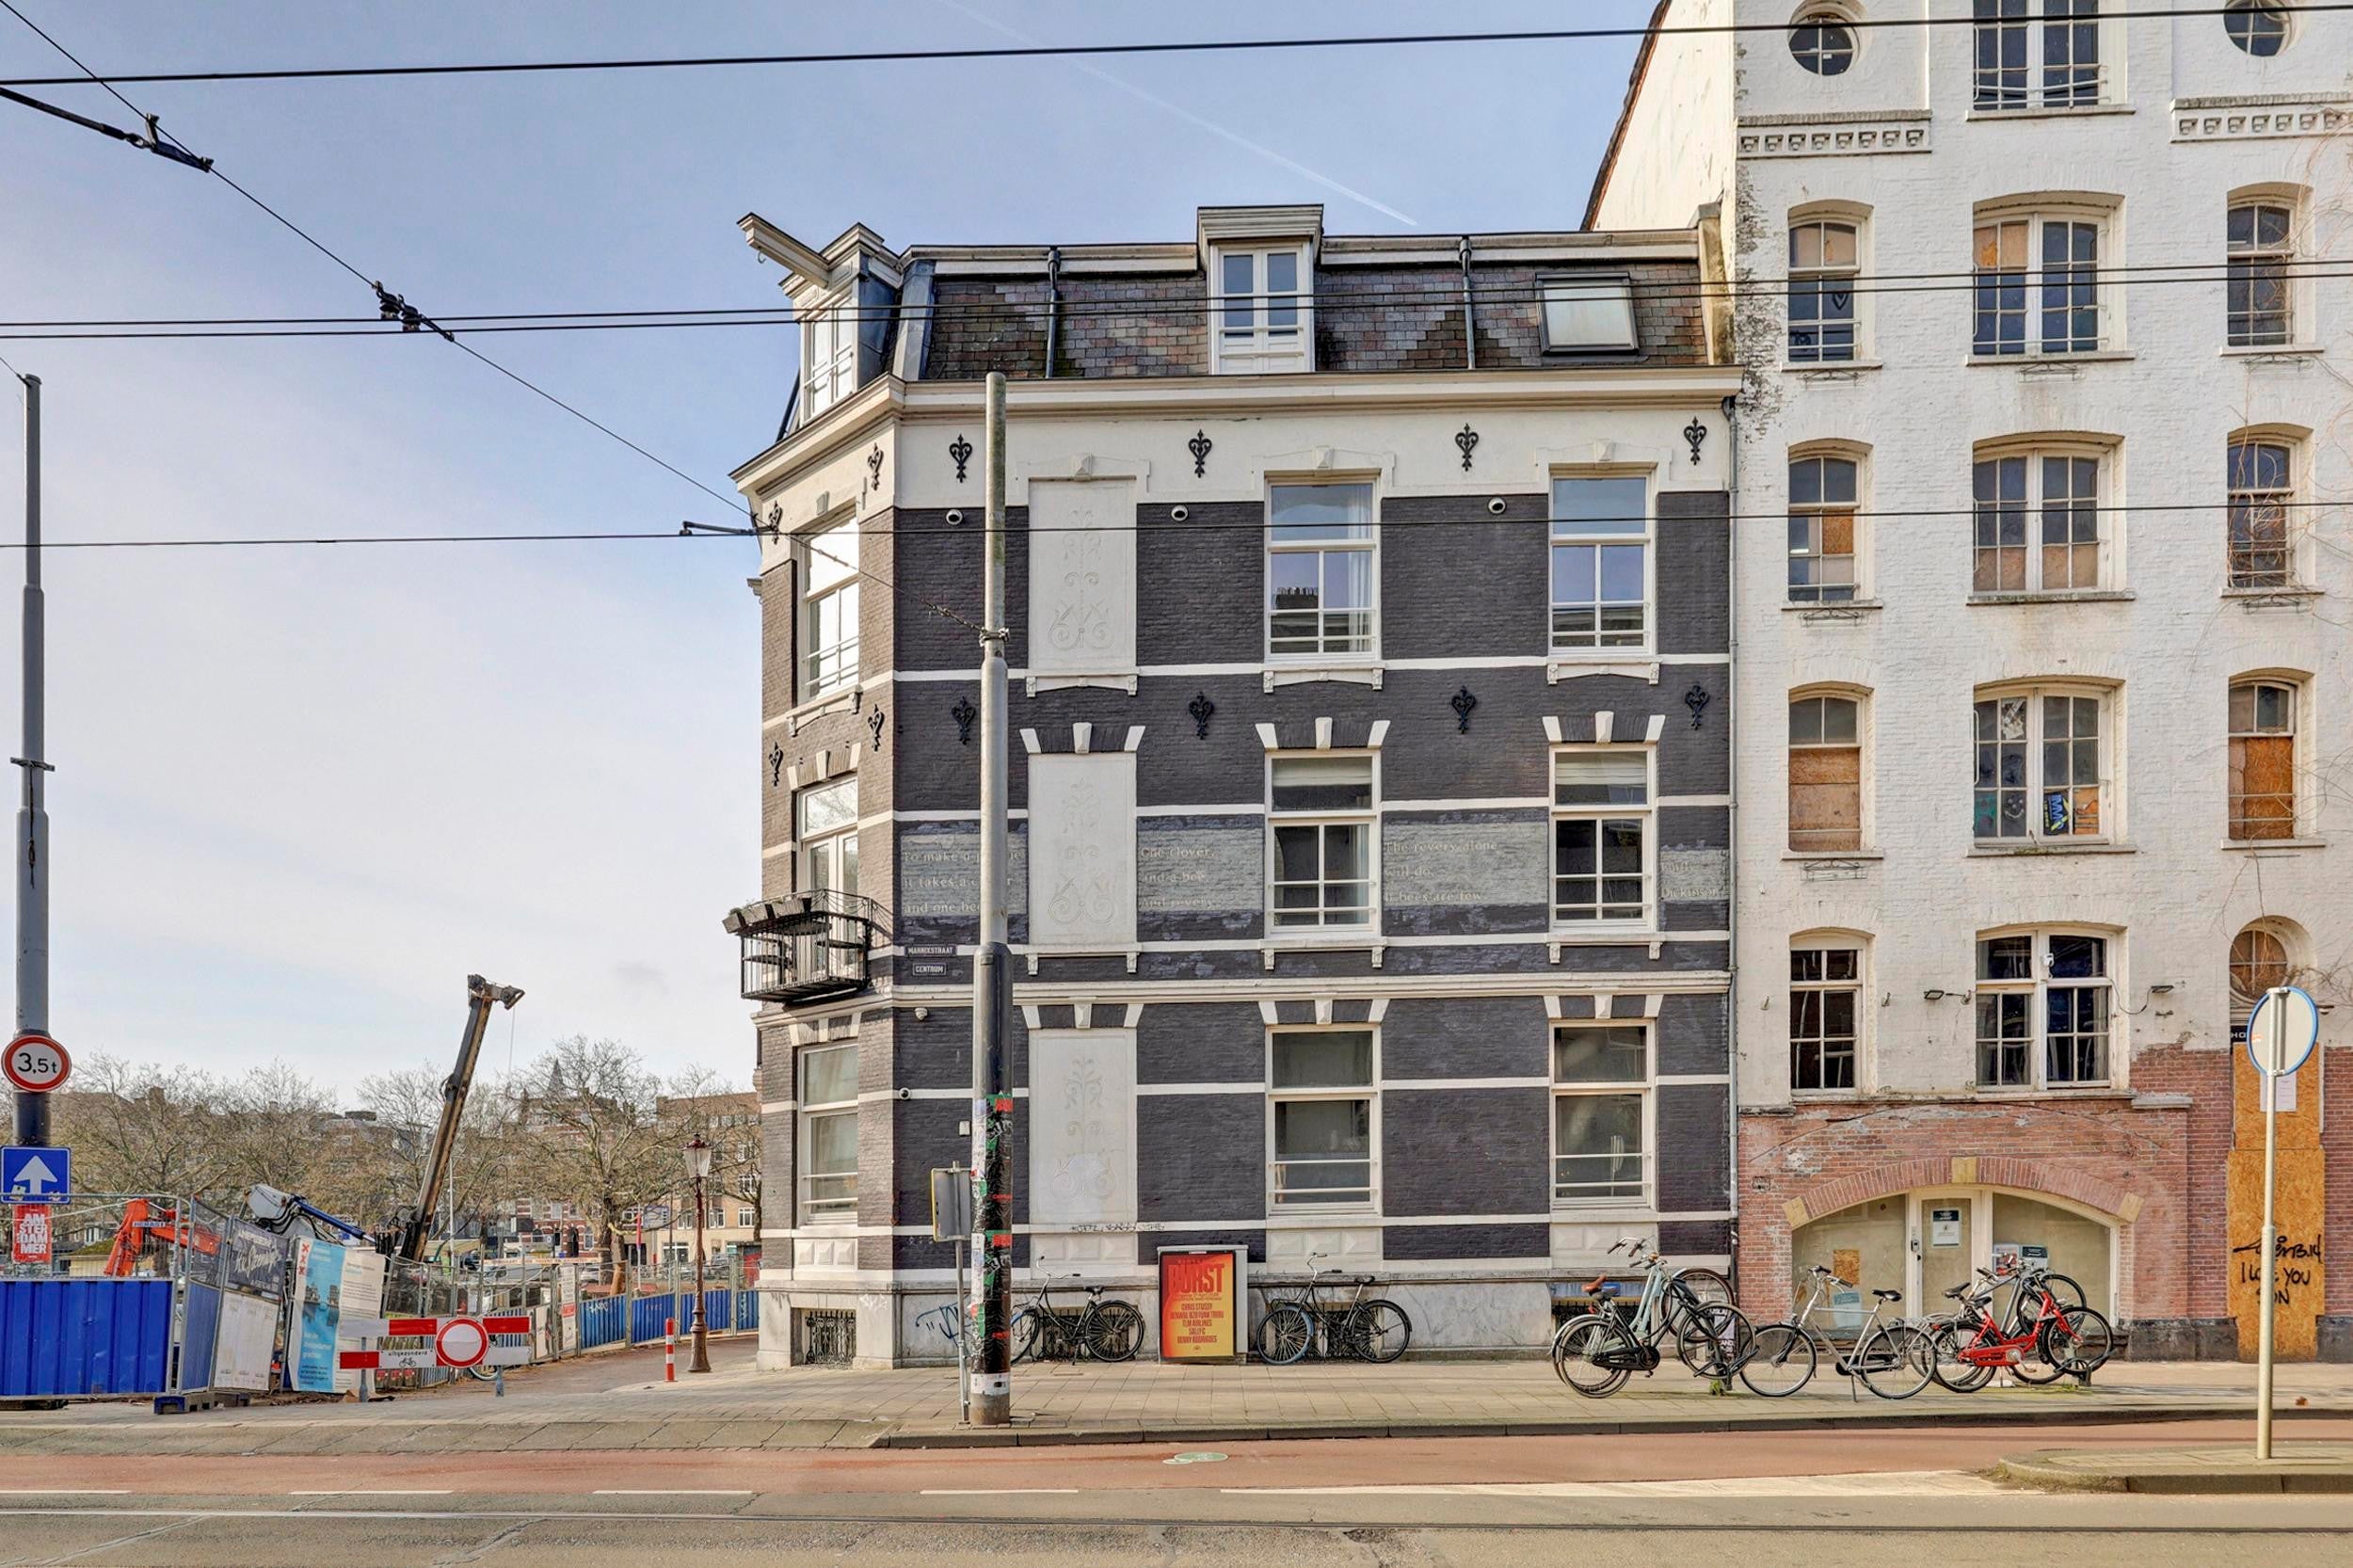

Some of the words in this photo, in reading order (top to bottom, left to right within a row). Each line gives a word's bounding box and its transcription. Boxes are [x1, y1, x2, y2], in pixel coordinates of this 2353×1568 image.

[1386, 841, 1409, 852] The
[1463, 840, 1498, 851] alone
[923, 851, 958, 862] make
[919, 876, 954, 887] takes
[904, 903, 928, 914] and
[933, 904, 956, 913] one
[907, 946, 953, 954] MARNIXSTRAAT
[24, 1213, 46, 1224] AM
[21, 1243, 47, 1254] MER
[1168, 1263, 1225, 1293] BURST
[2282, 1267, 2311, 1287] YOU
